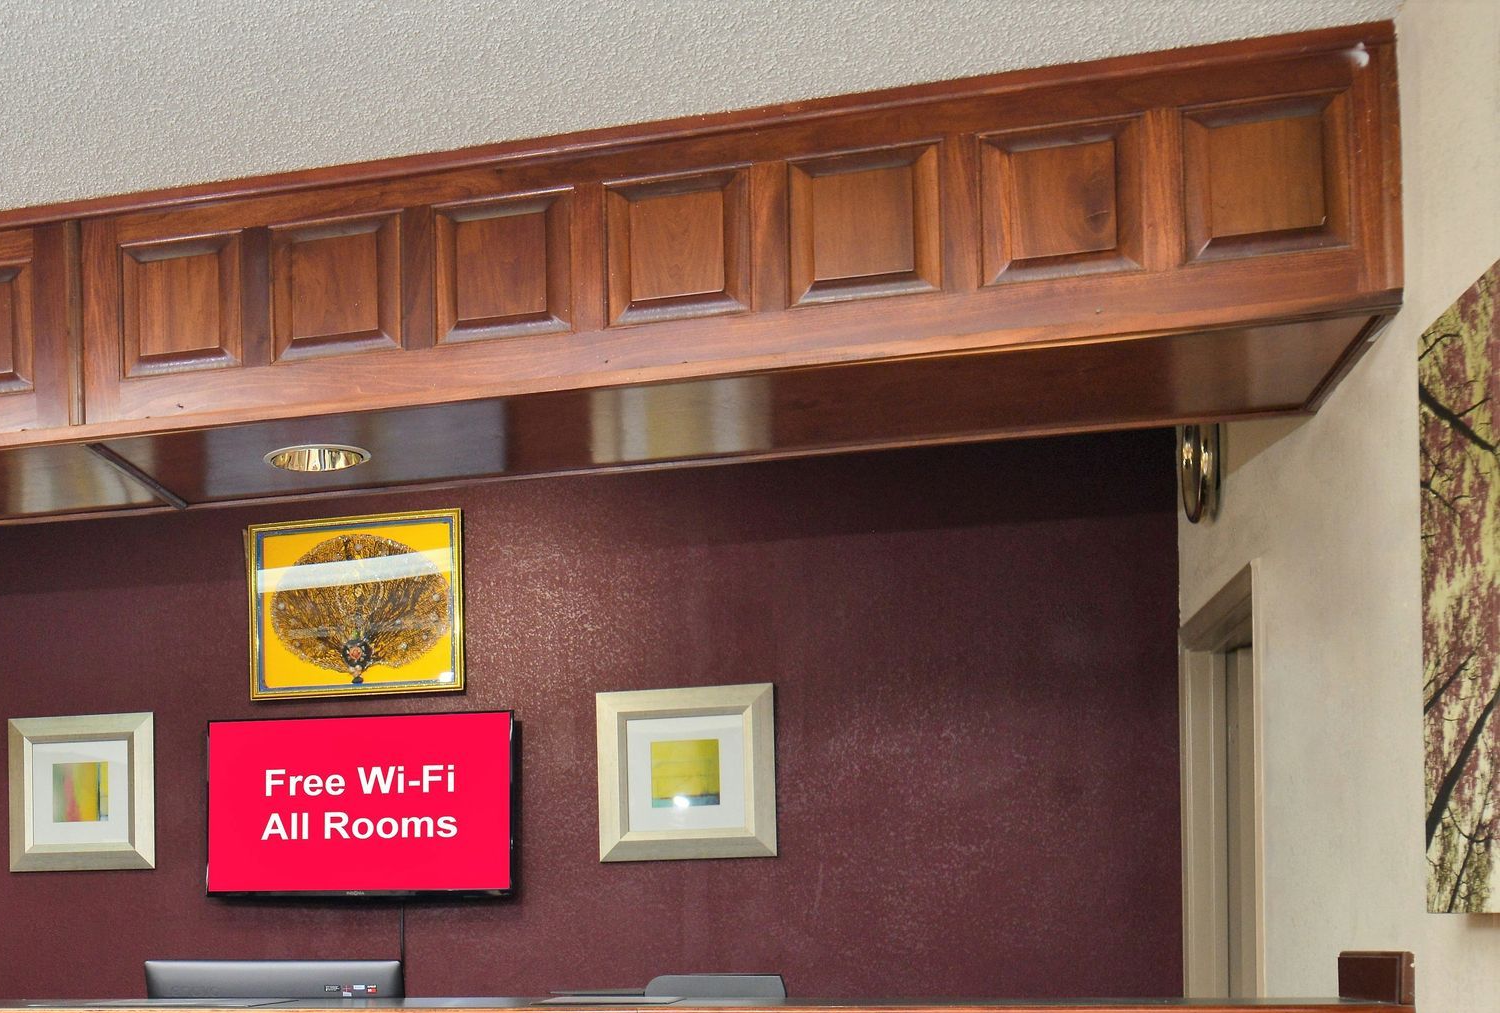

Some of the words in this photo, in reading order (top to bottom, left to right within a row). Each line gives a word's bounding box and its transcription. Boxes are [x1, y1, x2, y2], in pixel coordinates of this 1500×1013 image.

[265, 769, 346, 797] Free
[357, 764, 455, 795] Wi-Fi
[261, 812, 309, 840] All
[324, 811, 458, 839] Rooms
